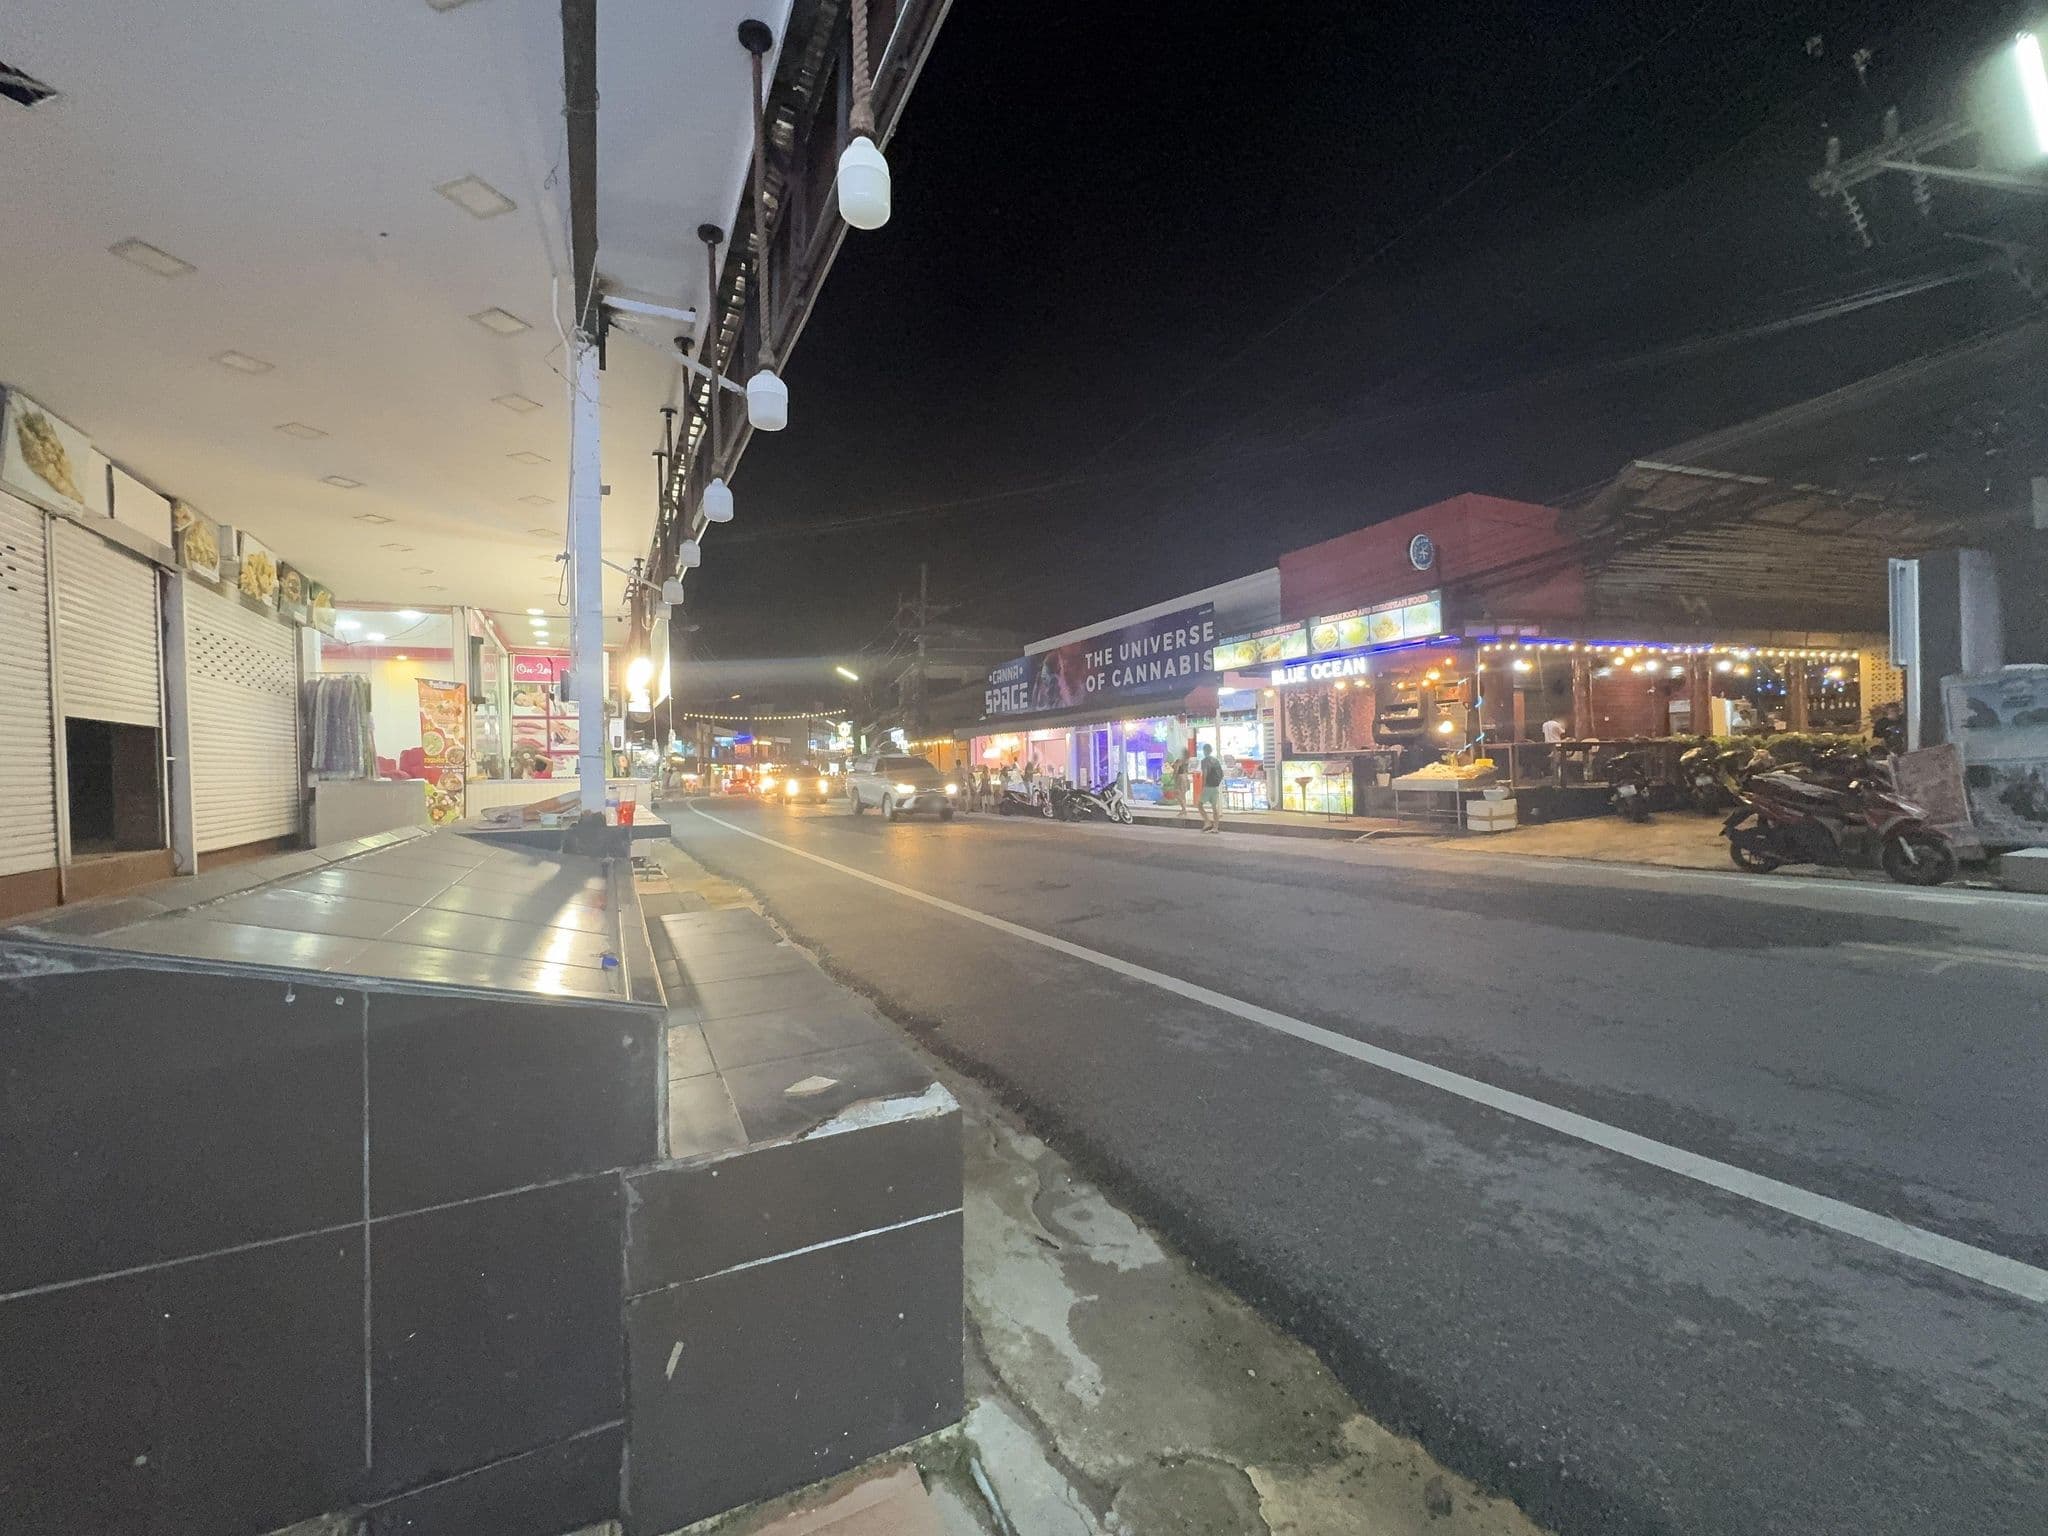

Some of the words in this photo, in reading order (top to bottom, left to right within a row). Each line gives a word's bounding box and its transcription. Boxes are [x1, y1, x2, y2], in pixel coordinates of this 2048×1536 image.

[1407, 594, 1429, 606] FOOD
[1085, 648, 1113, 670] THE
[1119, 621, 1215, 661] UNIVERSE
[992, 664, 1019, 685] CANNA
[1085, 673, 1106, 693] OF
[1111, 650, 1214, 688] CANNABIS
[1271, 665, 1308, 686] BLUE
[1311, 657, 1367, 680] OCEAN
[985, 682, 1028, 714] SPACE
